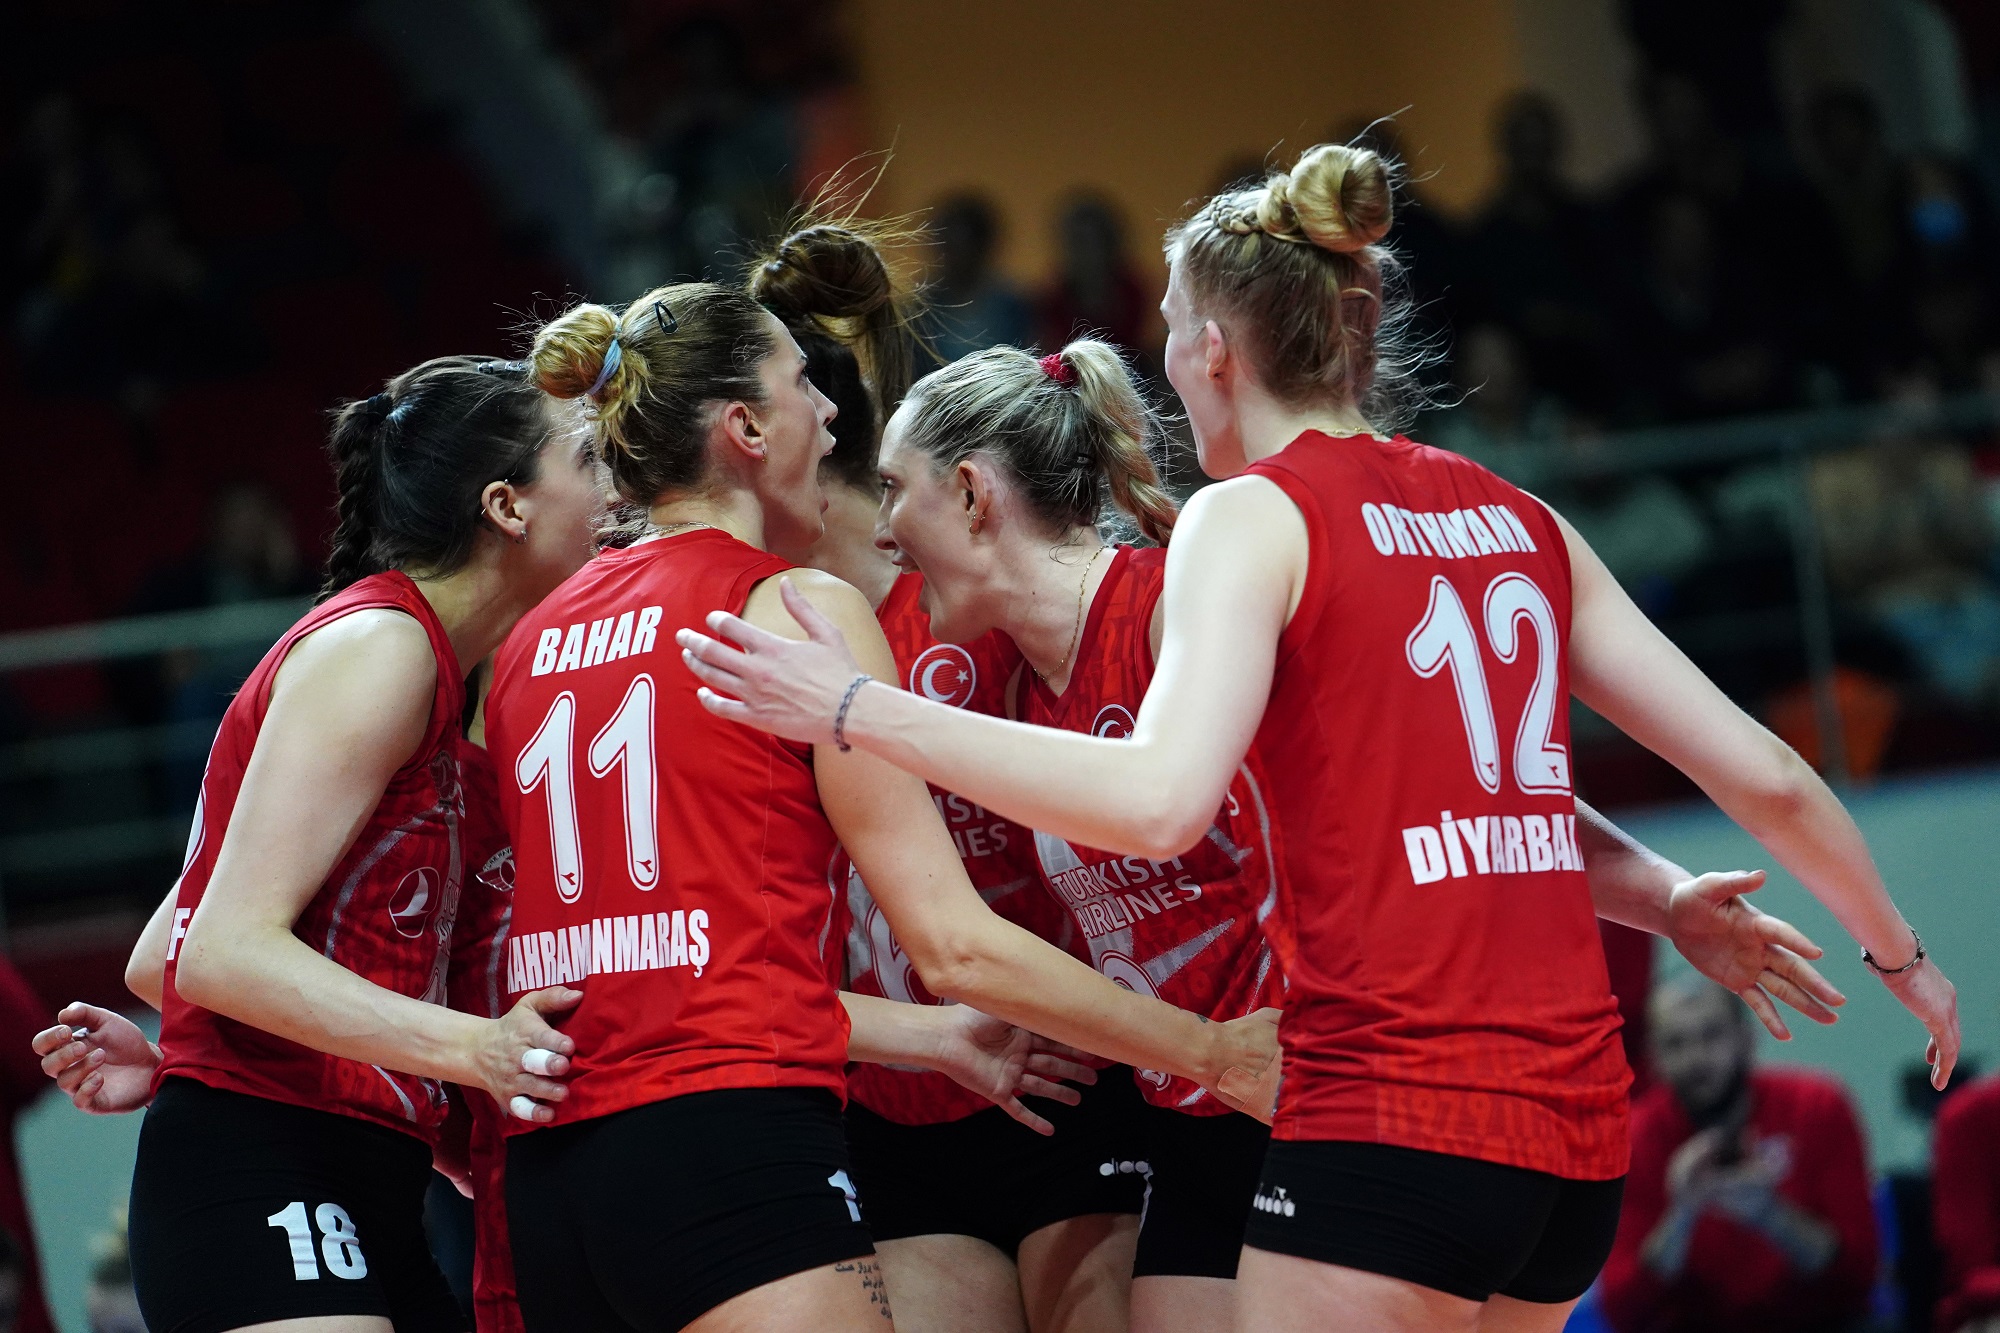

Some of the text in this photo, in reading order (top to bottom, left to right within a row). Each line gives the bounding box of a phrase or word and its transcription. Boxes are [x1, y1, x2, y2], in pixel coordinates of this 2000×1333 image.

[1362, 502, 1538, 559] ORTHMANN
[531, 605, 663, 677] BAHAR
[1405, 571, 1572, 795] 12
[515, 672, 660, 904] 11
[1051, 854, 1184, 905] TURKISH
[1074, 874, 1202, 939] AIRLINES
[507, 909, 710, 995] AHRAMNMARAŞ
[827, 1168, 863, 1222] 1
[267, 1201, 368, 1281] 18
